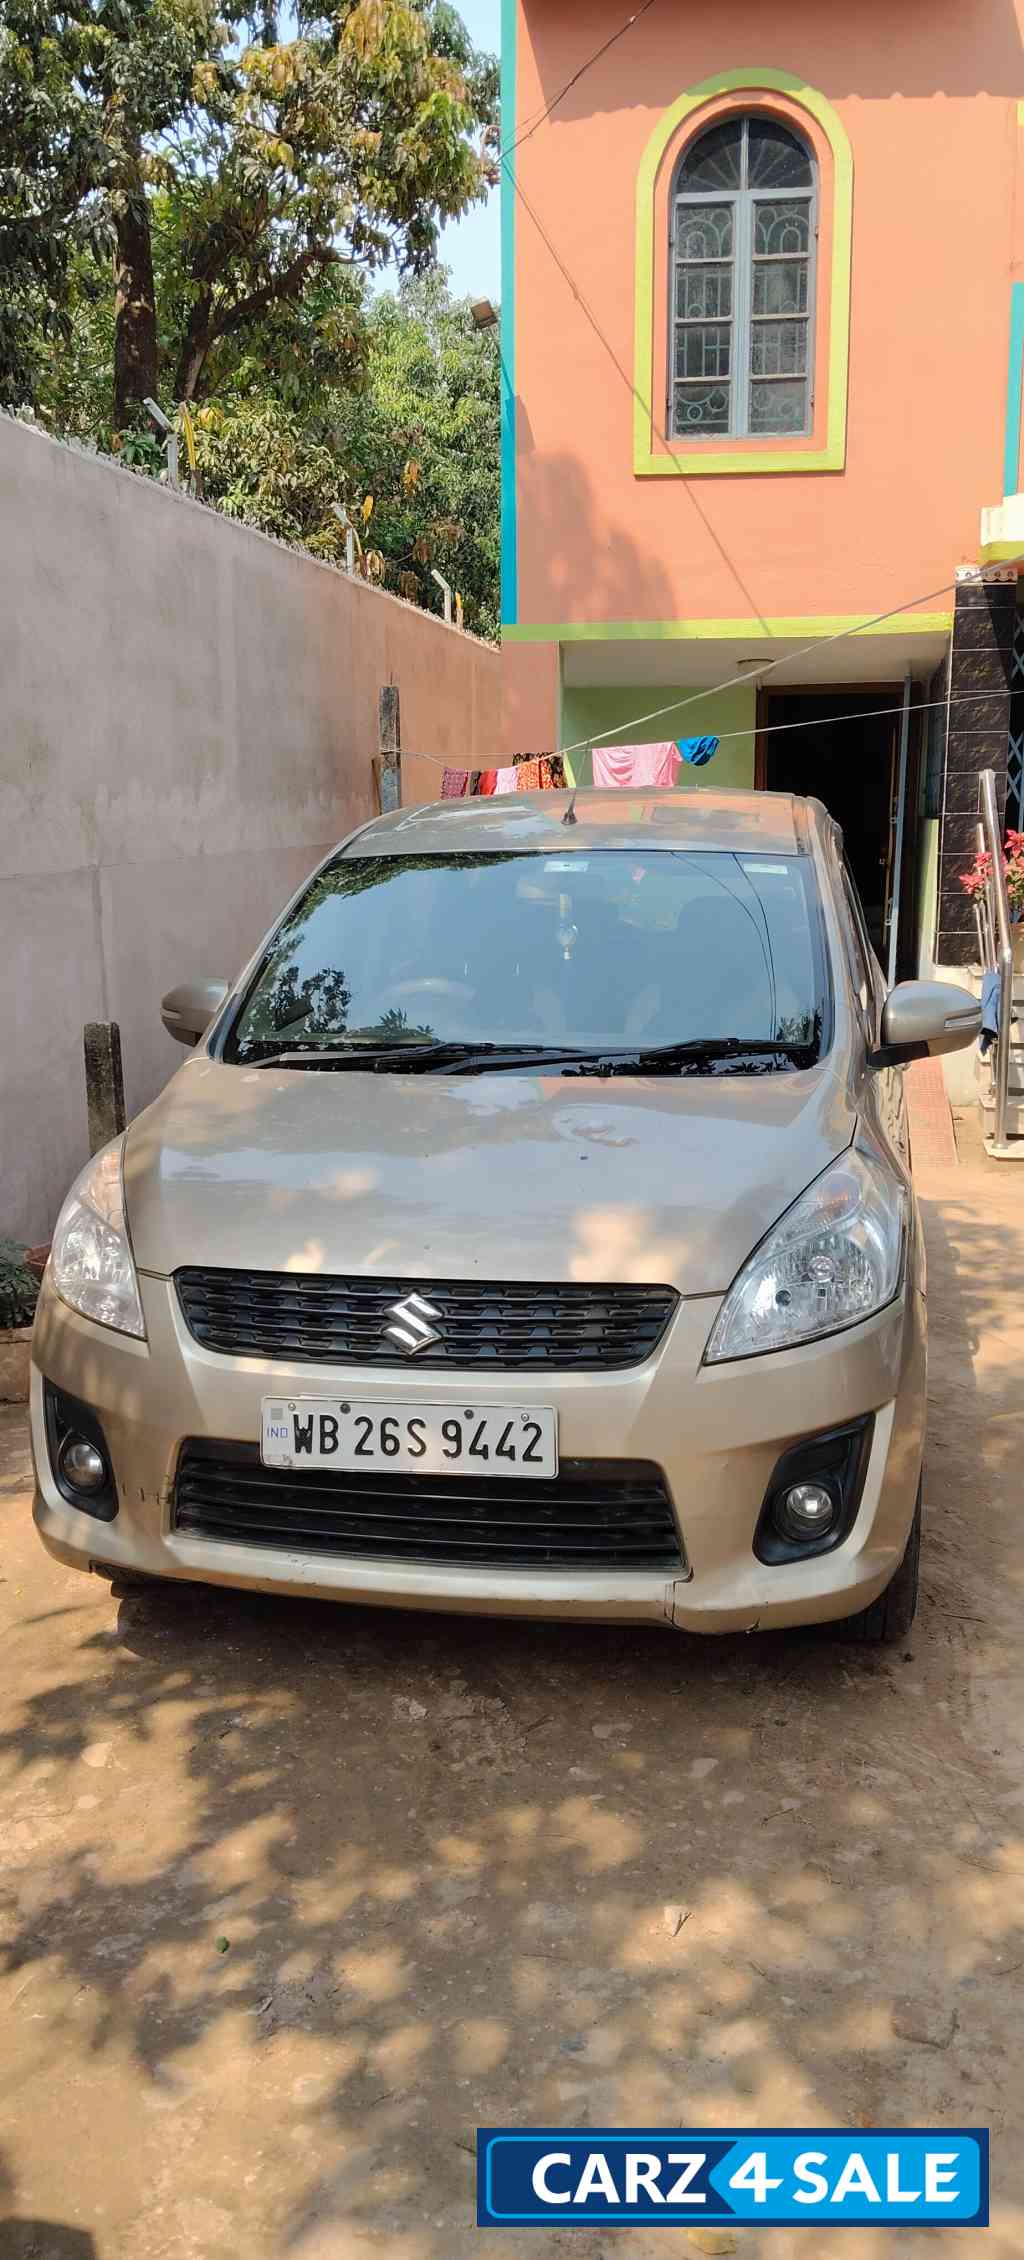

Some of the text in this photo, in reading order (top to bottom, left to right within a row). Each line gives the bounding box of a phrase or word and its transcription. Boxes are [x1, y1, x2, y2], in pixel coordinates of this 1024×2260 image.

[266, 1427, 288, 1439] IND
[292, 1414, 544, 1462] WB 26S 9442
